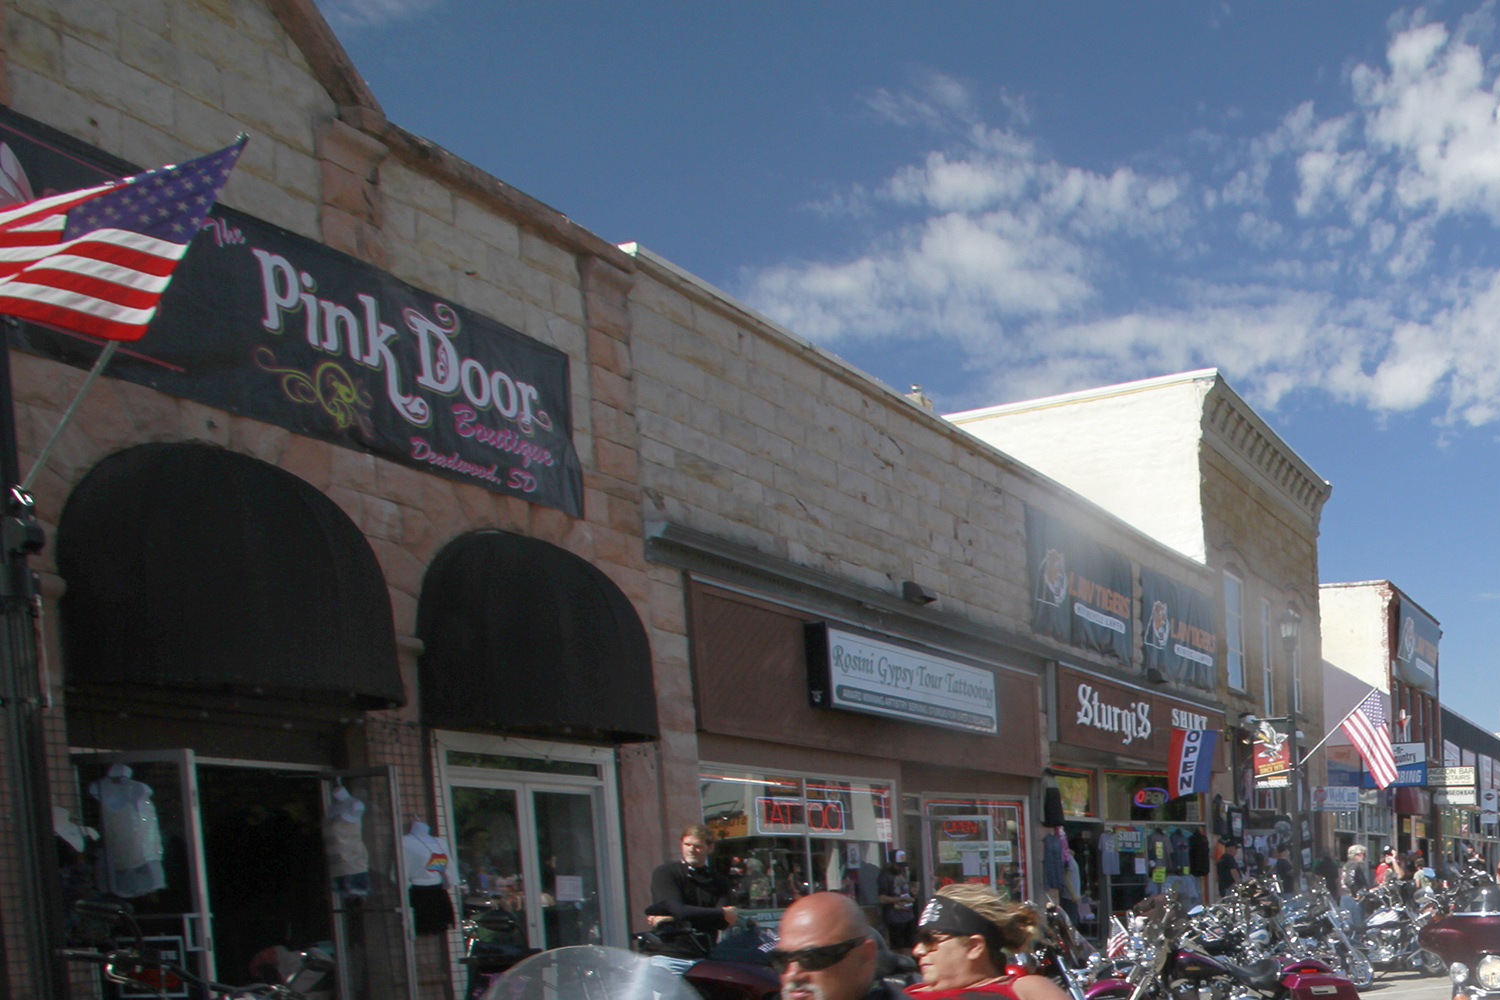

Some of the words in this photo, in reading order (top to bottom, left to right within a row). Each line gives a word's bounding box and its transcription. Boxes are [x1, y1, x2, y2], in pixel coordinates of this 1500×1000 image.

[203, 218, 246, 247] The
[252, 248, 430, 427] Pink
[404, 303, 553, 434] Door
[453, 404, 555, 467] Boutique
[411, 437, 500, 483] Deadwood,
[507, 467, 538, 492] SD
[833, 645, 874, 673] Rosini
[878, 656, 914, 690] Gypsy
[916, 665, 944, 690] Tour
[945, 672, 993, 708] Tattooing
[1171, 708, 1208, 730] SHIRT
[1179, 730, 1200, 790] OPEN
[1136, 790, 1165, 804] OPEN
[757, 799, 842, 831] TATOO
[943, 820, 978, 833] OPEN
[1118, 830, 1141, 842] SHIRT
